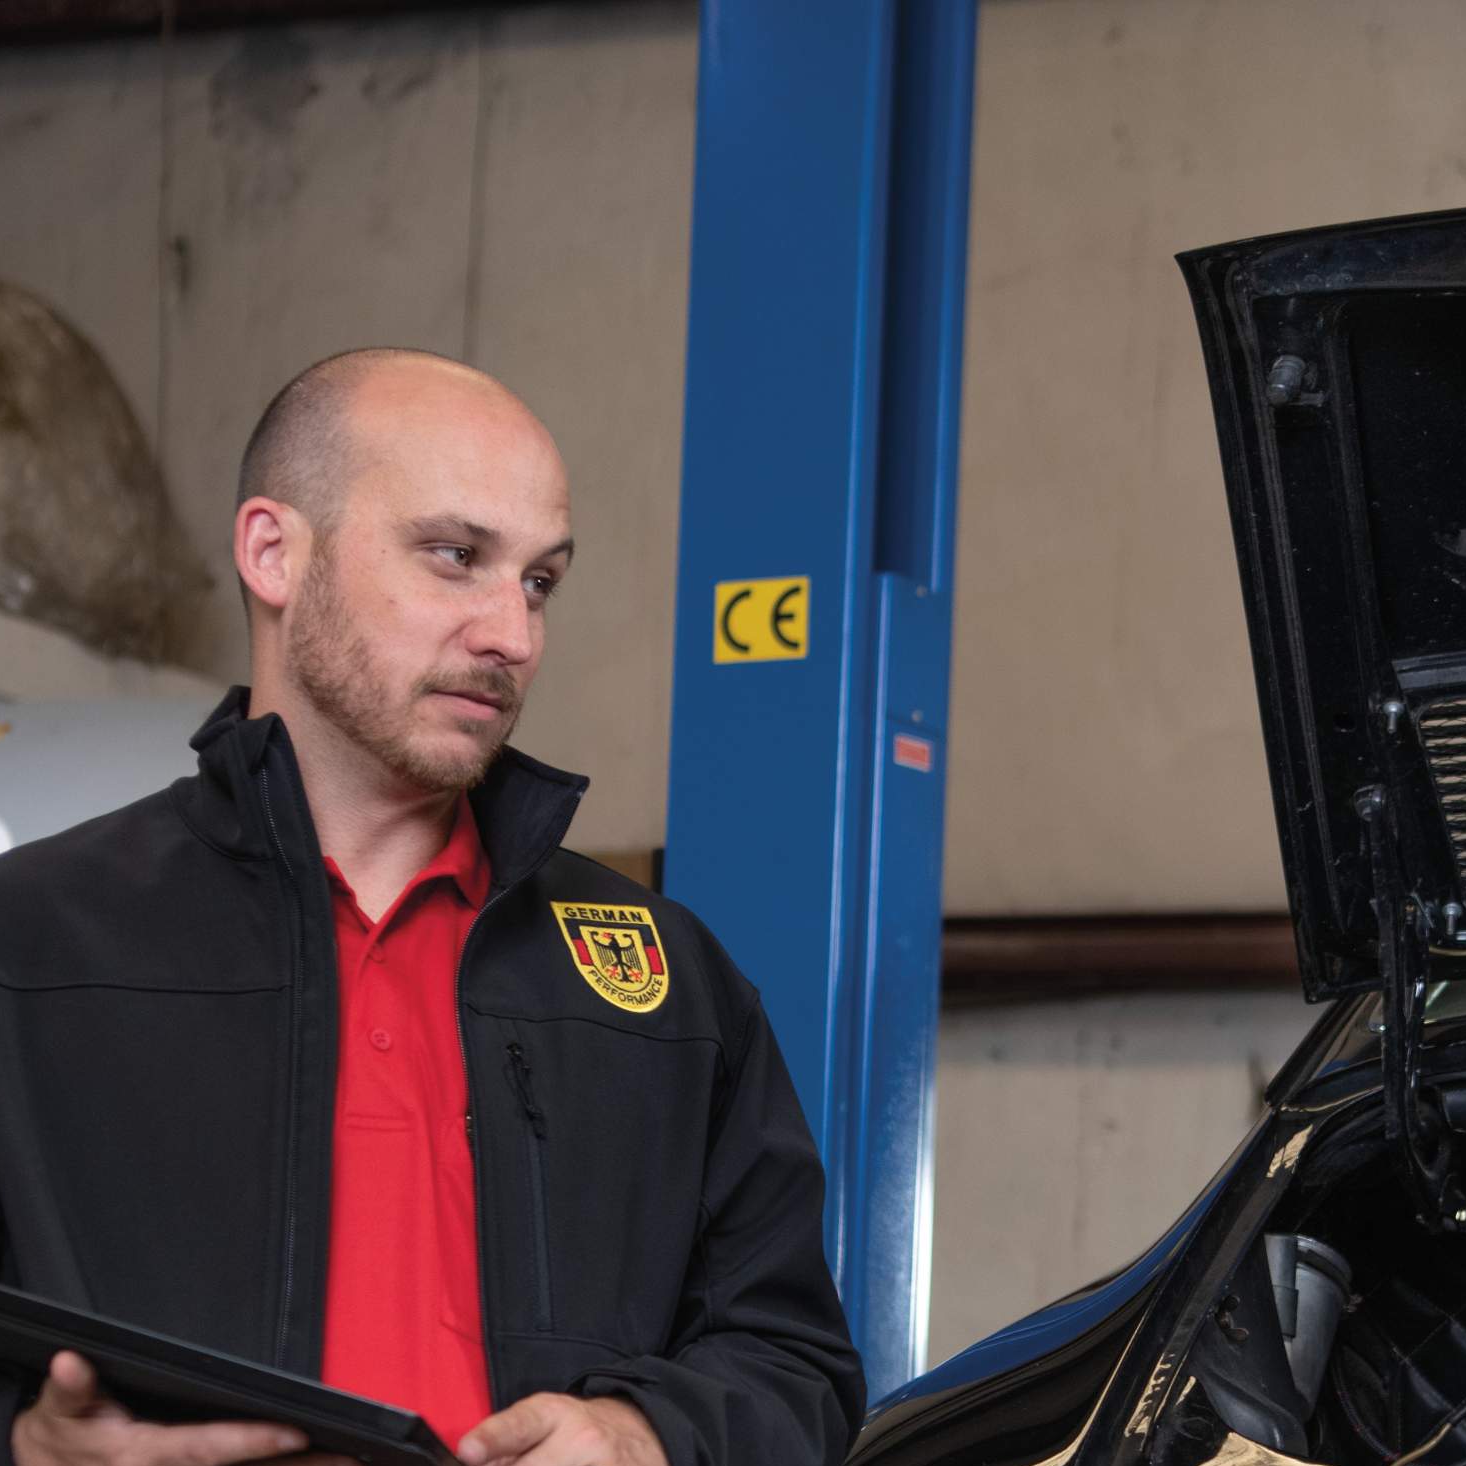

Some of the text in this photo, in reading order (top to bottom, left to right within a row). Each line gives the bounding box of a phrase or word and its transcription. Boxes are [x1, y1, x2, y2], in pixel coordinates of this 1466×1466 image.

[720, 585, 802, 655] CE
[564, 906, 643, 921] GERMAN
[587, 969, 664, 1006] PERFORMANCE
